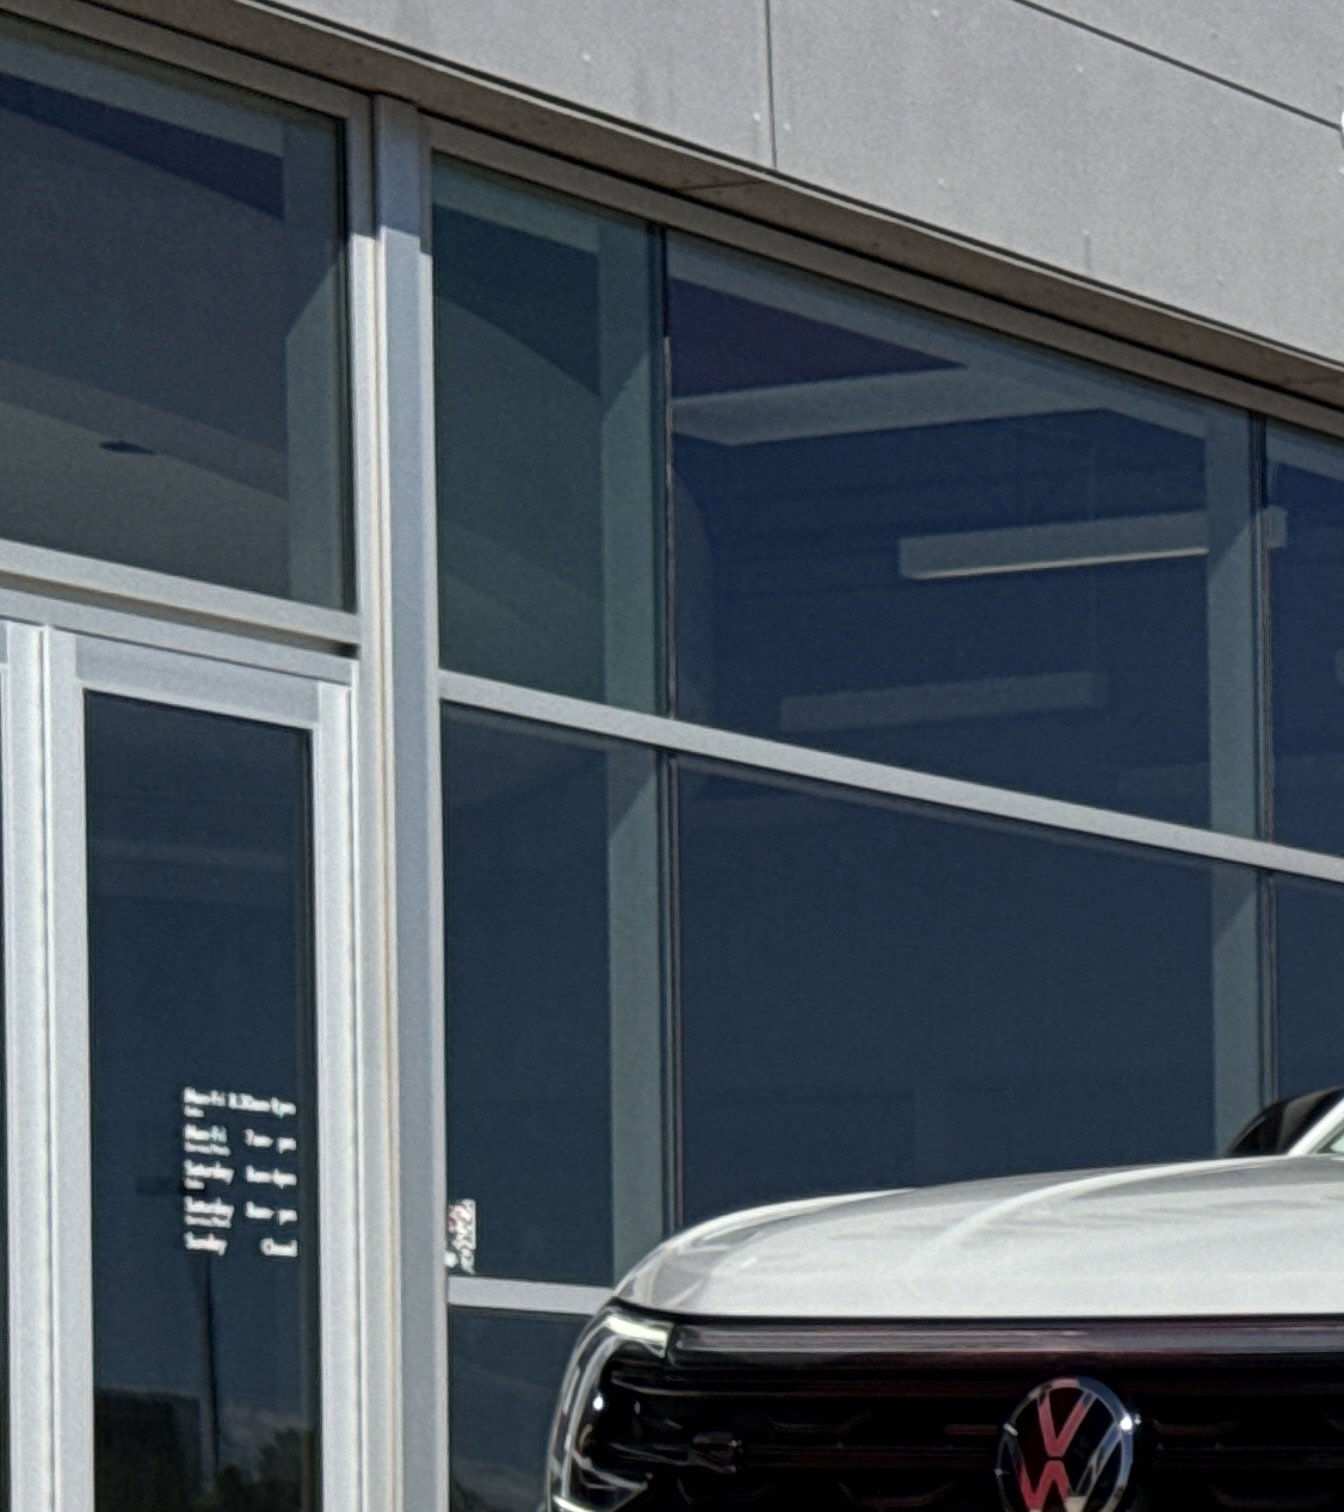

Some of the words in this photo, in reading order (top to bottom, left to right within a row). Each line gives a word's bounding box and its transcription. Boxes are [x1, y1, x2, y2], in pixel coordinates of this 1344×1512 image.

[184, 1087, 226, 1107] M-Fri
[184, 1123, 227, 1143] M-Fri
[184, 1159, 234, 1184] Stdy
[184, 1196, 234, 1216] Stdy
[184, 1231, 228, 1256] Sdy
[261, 1237, 298, 1257] Cld
